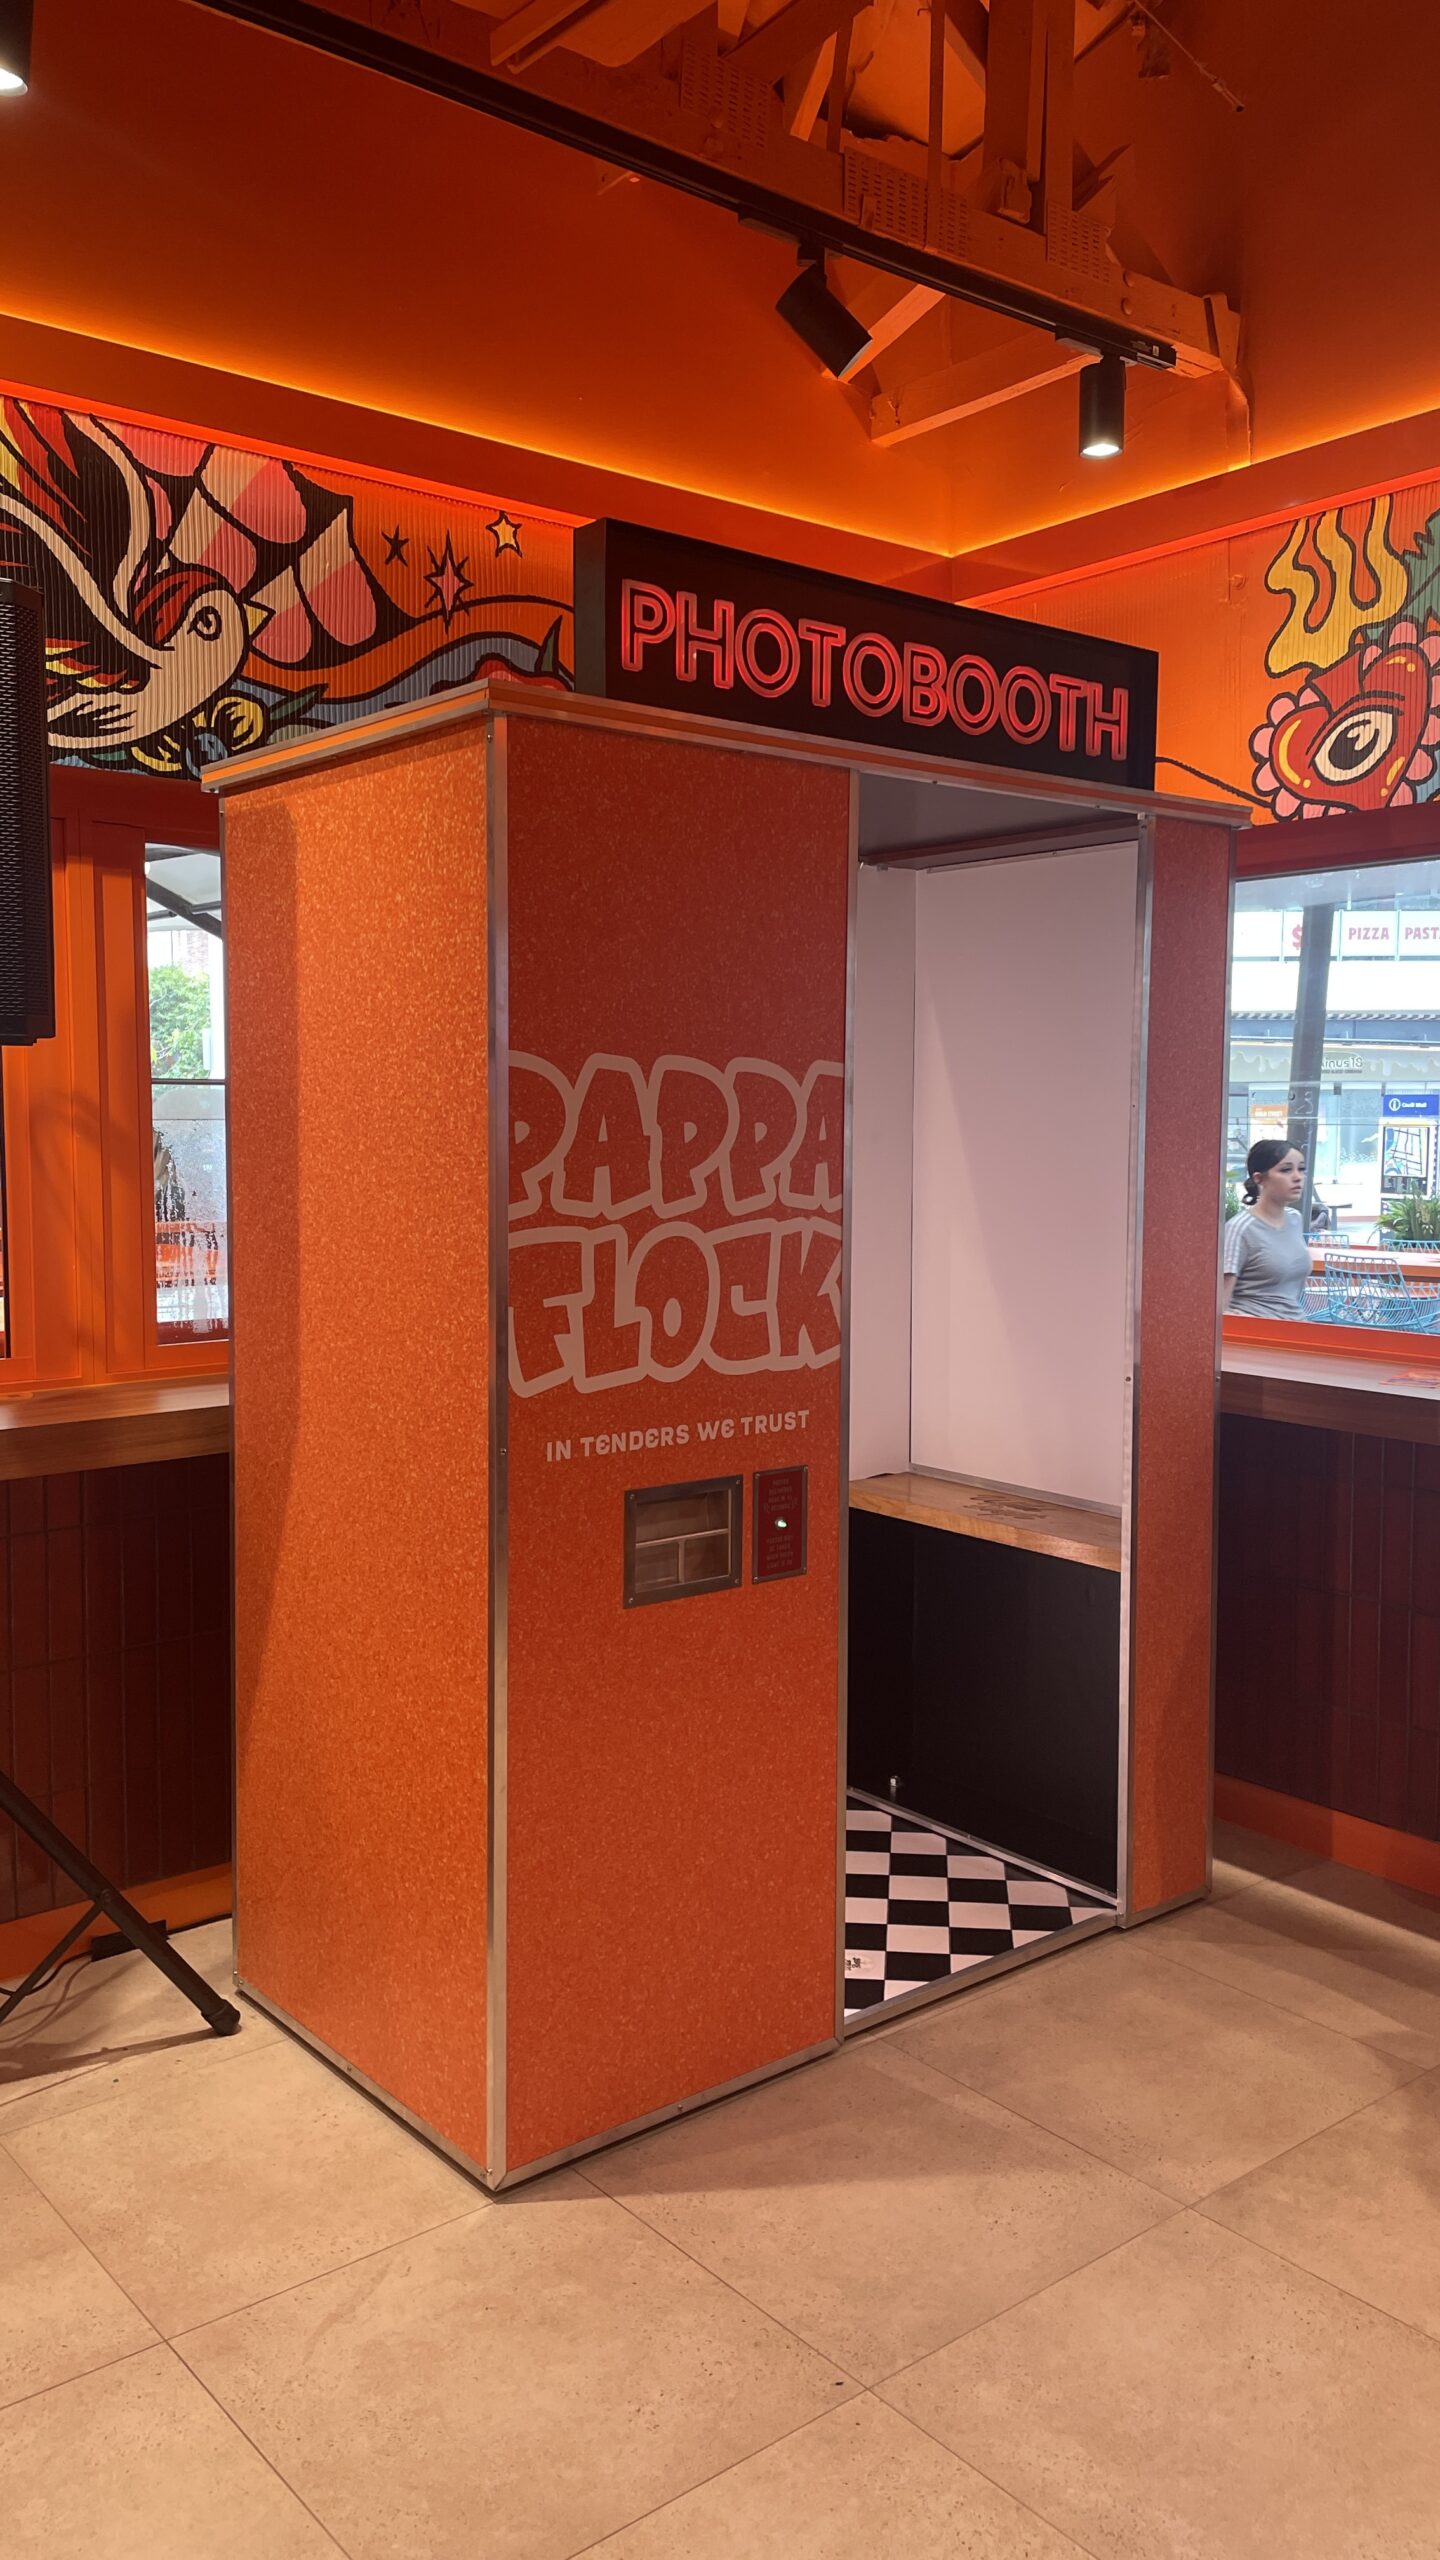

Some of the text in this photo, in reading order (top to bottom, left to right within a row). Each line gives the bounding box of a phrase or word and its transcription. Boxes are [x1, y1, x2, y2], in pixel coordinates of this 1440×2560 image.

[620, 578, 1129, 761] PHOTOBOOTH
[1348, 927, 1389, 940] PIZZA
[1405, 927, 1440, 940] PAST
[1321, 1056, 1363, 1068] inus18
[508, 1050, 844, 1221] PAPPA
[508, 1217, 842, 1398] FLOCK
[546, 1410, 810, 1462] IN TENDERS WE TRUST
